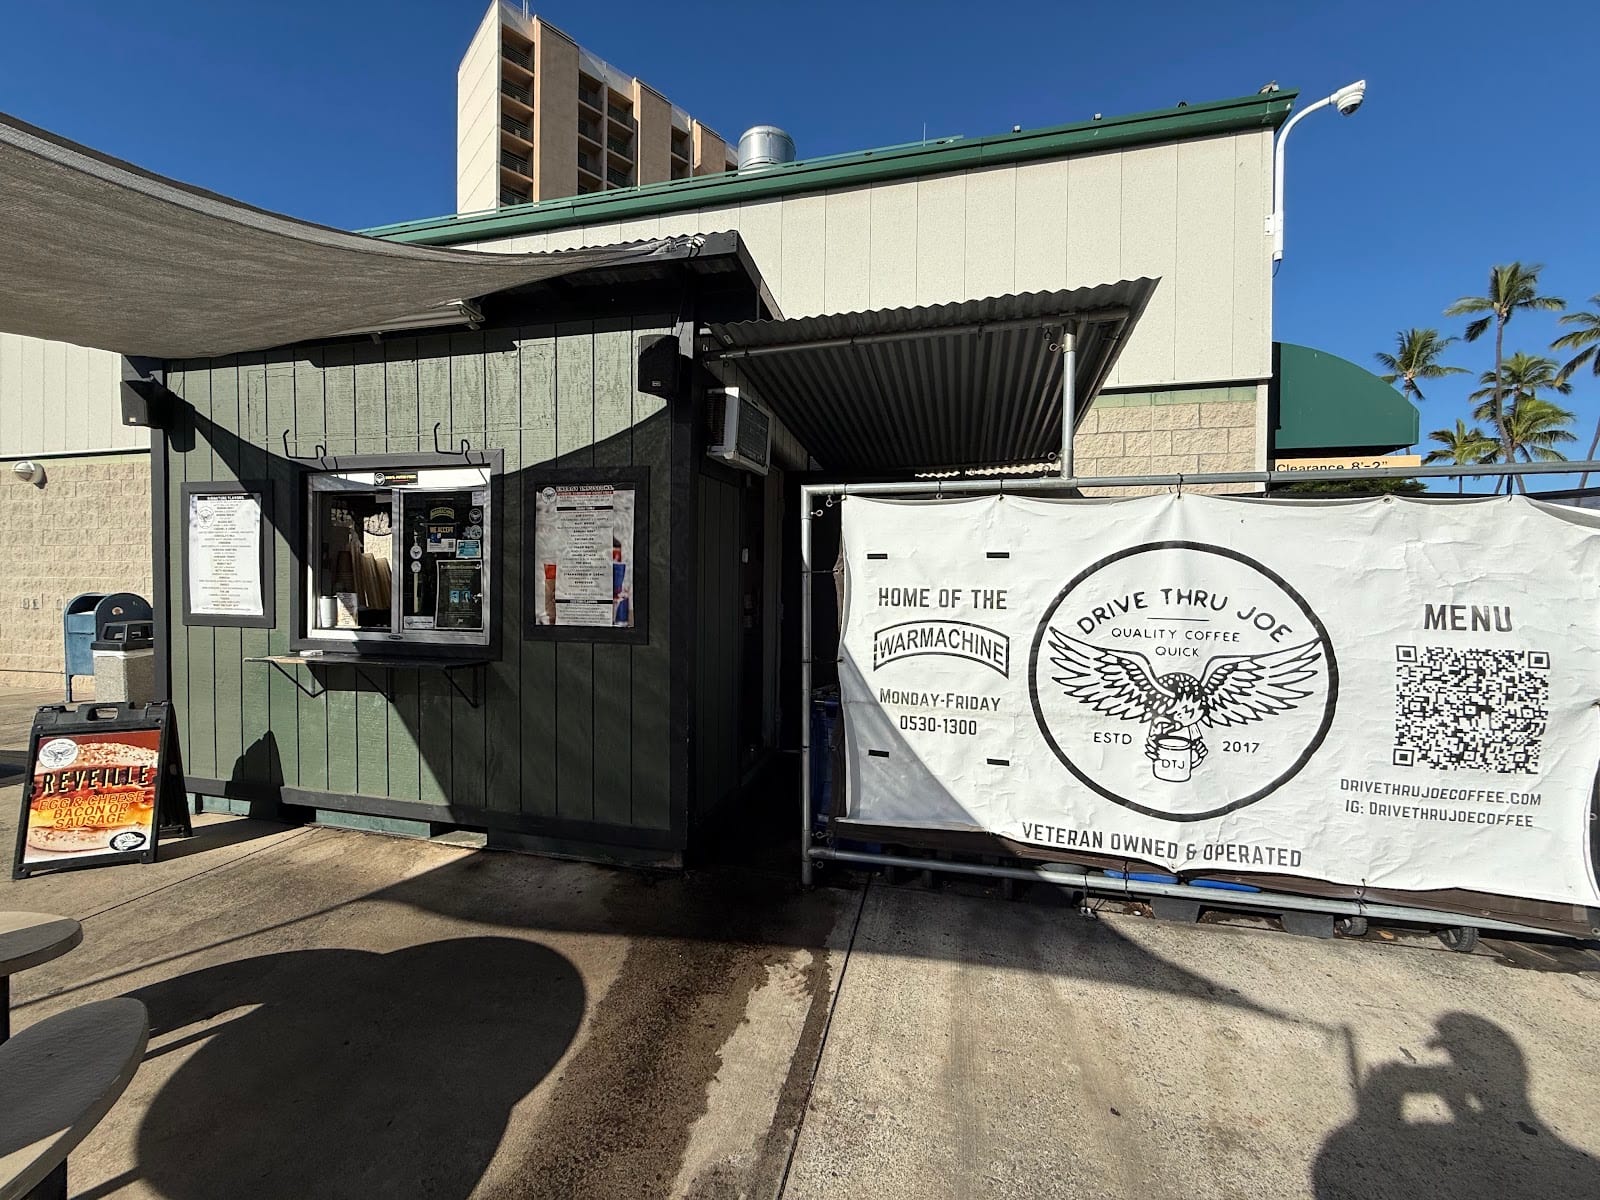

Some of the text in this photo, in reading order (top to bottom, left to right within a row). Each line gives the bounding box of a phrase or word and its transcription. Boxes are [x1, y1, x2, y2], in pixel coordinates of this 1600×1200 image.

[878, 587, 1008, 610] HOME OF THE
[1076, 588, 1293, 643] DRIVE THRU JOE
[1423, 603, 1513, 633] MENU
[1111, 627, 1240, 642] QUALITY COFFEE
[879, 627, 1004, 666] WARMACHINE
[1155, 646, 1199, 657] QUICK
[879, 688, 1001, 713] MONDAY-FRIDAY
[899, 715, 977, 736] 0530-1300
[1093, 731, 1132, 745] ESTD
[1222, 740, 1260, 754] 2017
[1161, 758, 1185, 770] DTJ
[43, 766, 149, 794] REVEILLE
[40, 791, 145, 811] EGG & CHEESE
[1340, 778, 1541, 806] DRIVETHRUJOECOFFEE.COM
[53, 802, 129, 819] BACON OR
[55, 813, 125, 829] SAUSAGE
[1345, 799, 1533, 828] IG: DRIVETHRUJOECOFFEE
[1022, 822, 1302, 869] VETERAN OWNED & OPERATED
